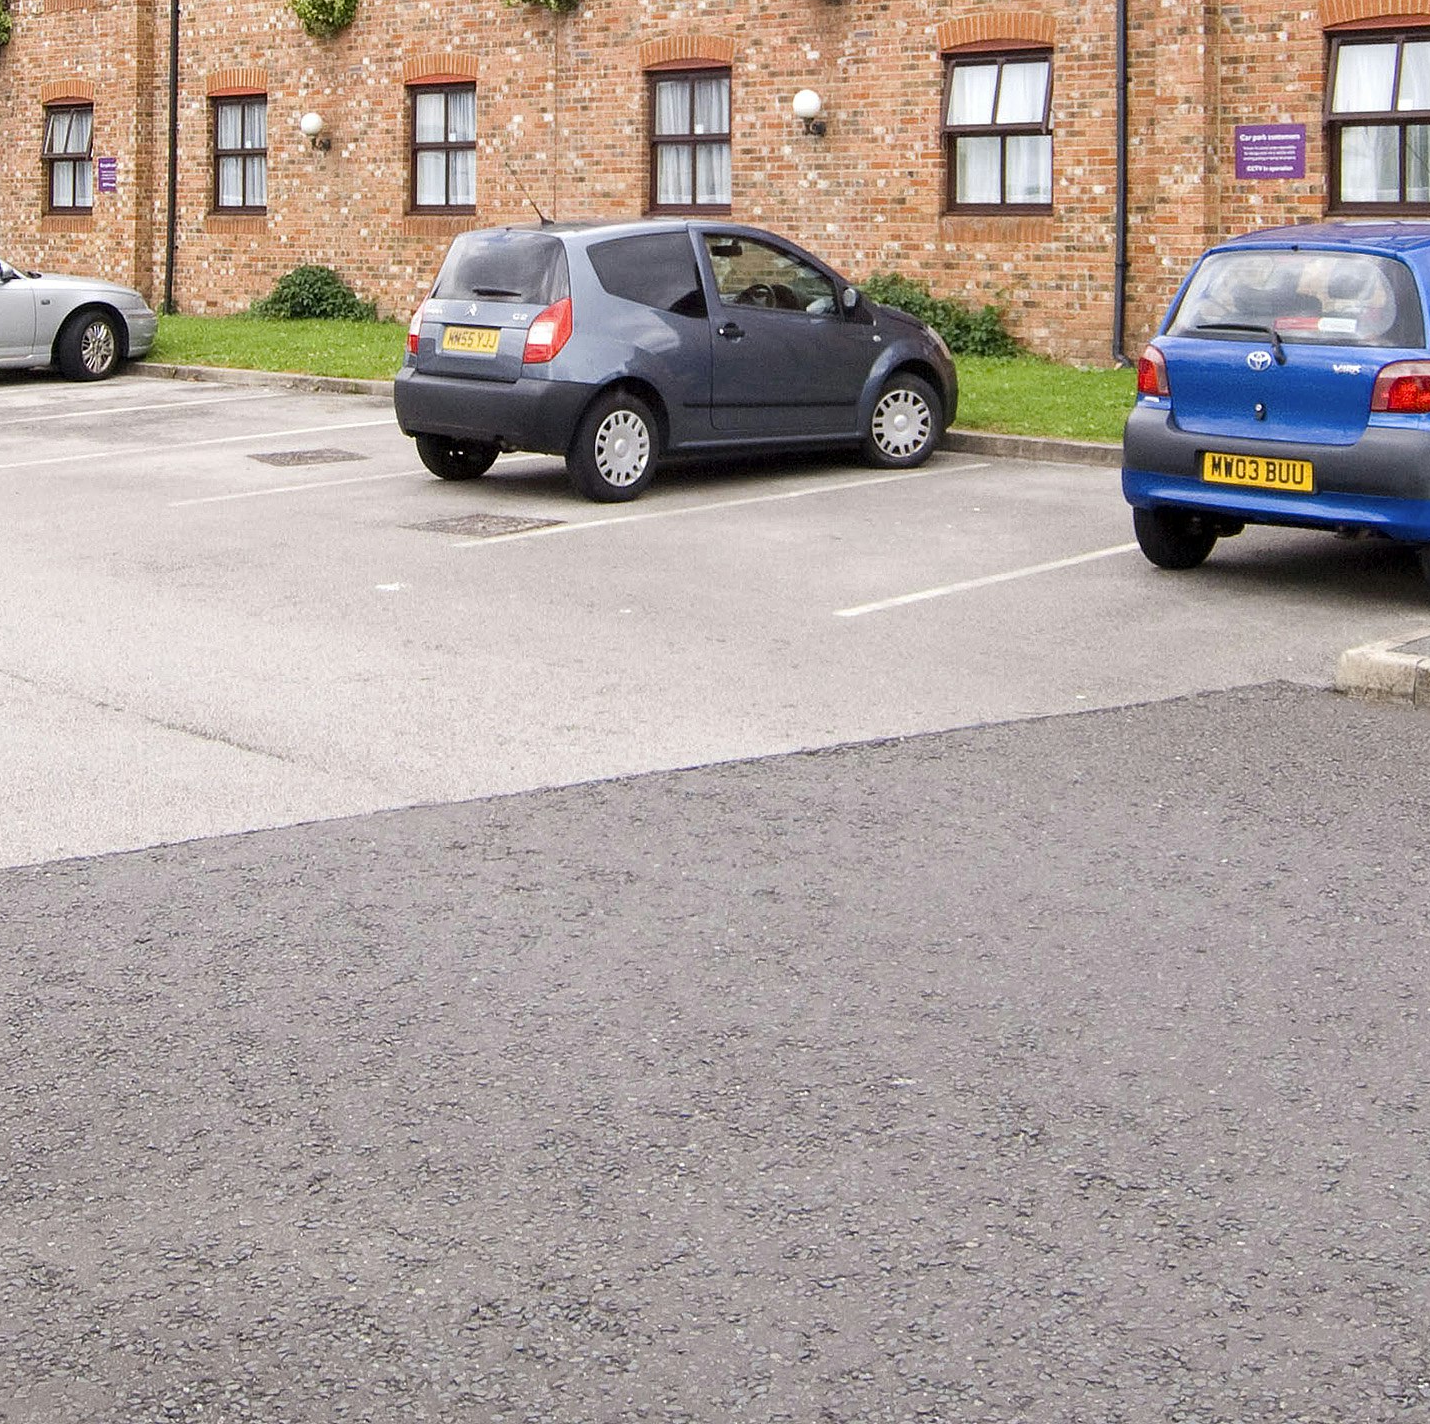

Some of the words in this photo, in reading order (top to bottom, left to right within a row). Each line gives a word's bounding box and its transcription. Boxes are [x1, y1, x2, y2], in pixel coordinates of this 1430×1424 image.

[1240, 134, 1251, 142] Car
[1211, 456, 1259, 480] MW03
[1265, 461, 1305, 484] BUU
